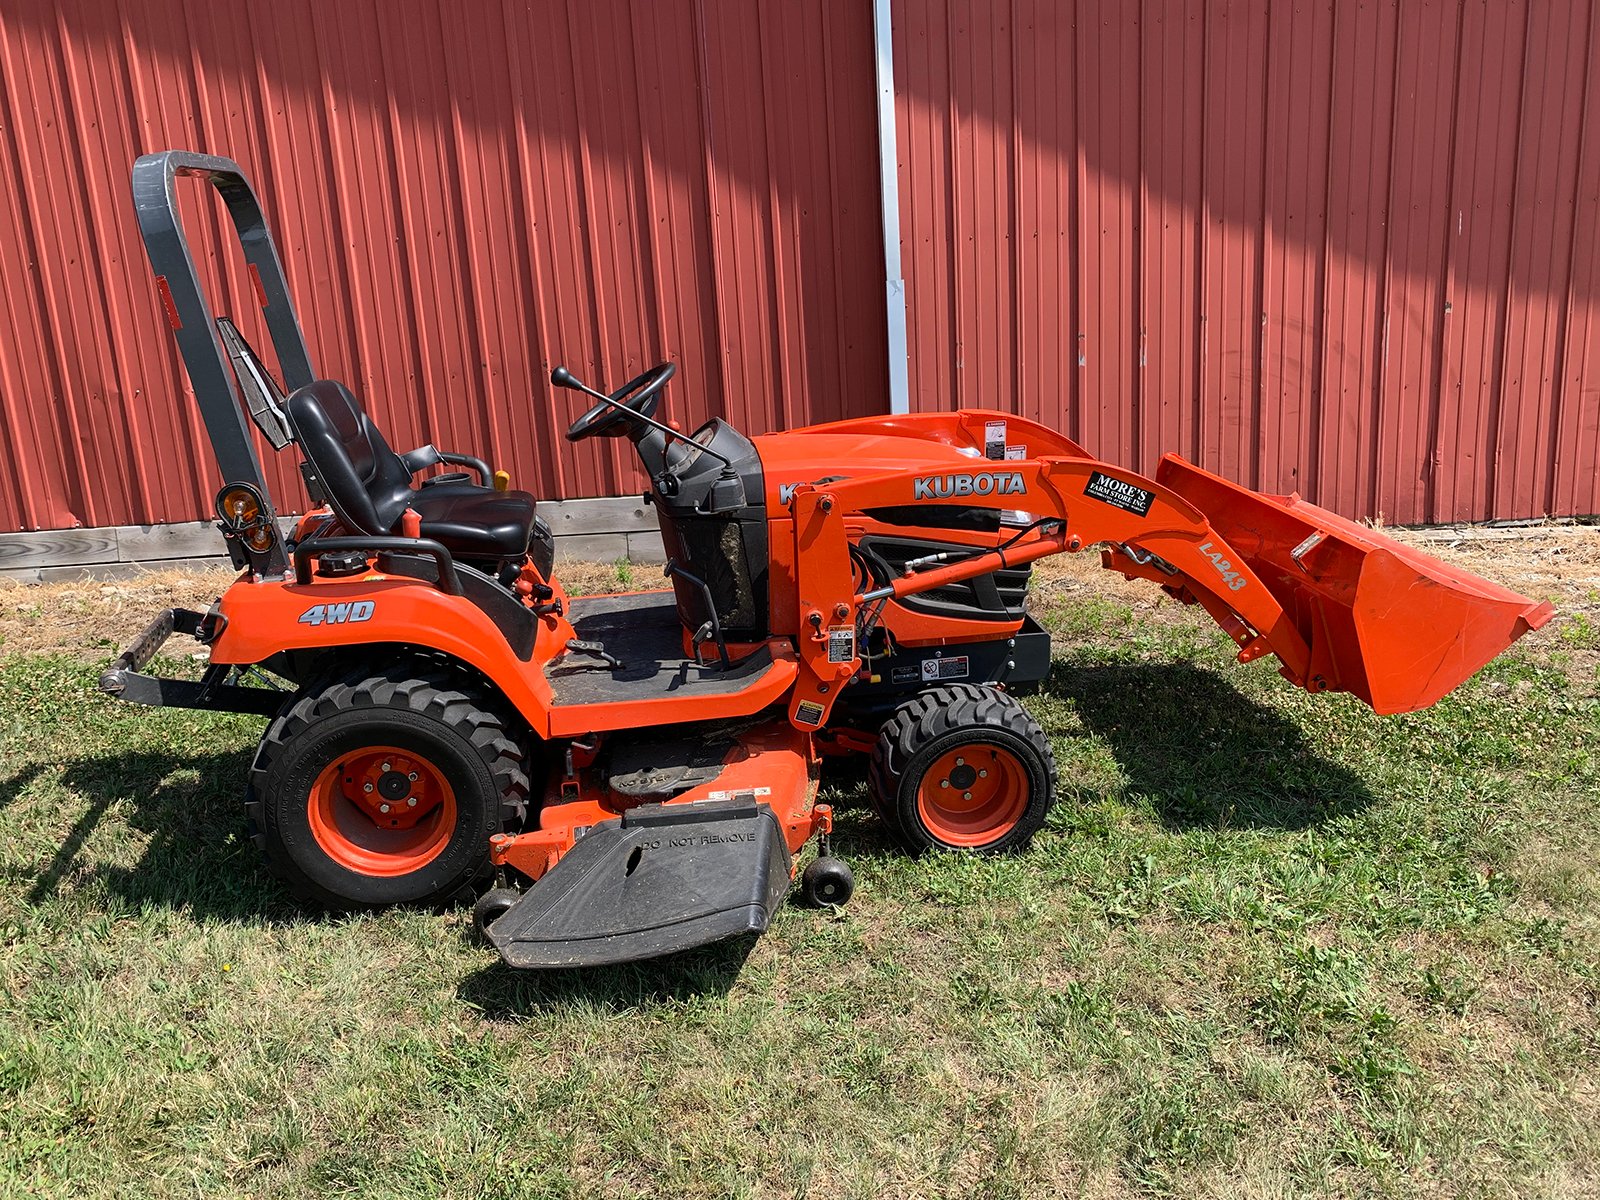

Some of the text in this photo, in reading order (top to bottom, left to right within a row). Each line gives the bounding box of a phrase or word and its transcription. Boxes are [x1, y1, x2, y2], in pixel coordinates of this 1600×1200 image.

[914, 472, 1026, 500] KUBOTA
[1090, 482, 1109, 495] FARM
[1110, 490, 1133, 504] STORE
[1132, 499, 1146, 510] INC.
[1097, 475, 1148, 501] MORE'S
[1199, 542, 1247, 591] LA243
[298, 600, 376, 626] 4WD
[641, 833, 756, 851] DO NOT REMOVE
